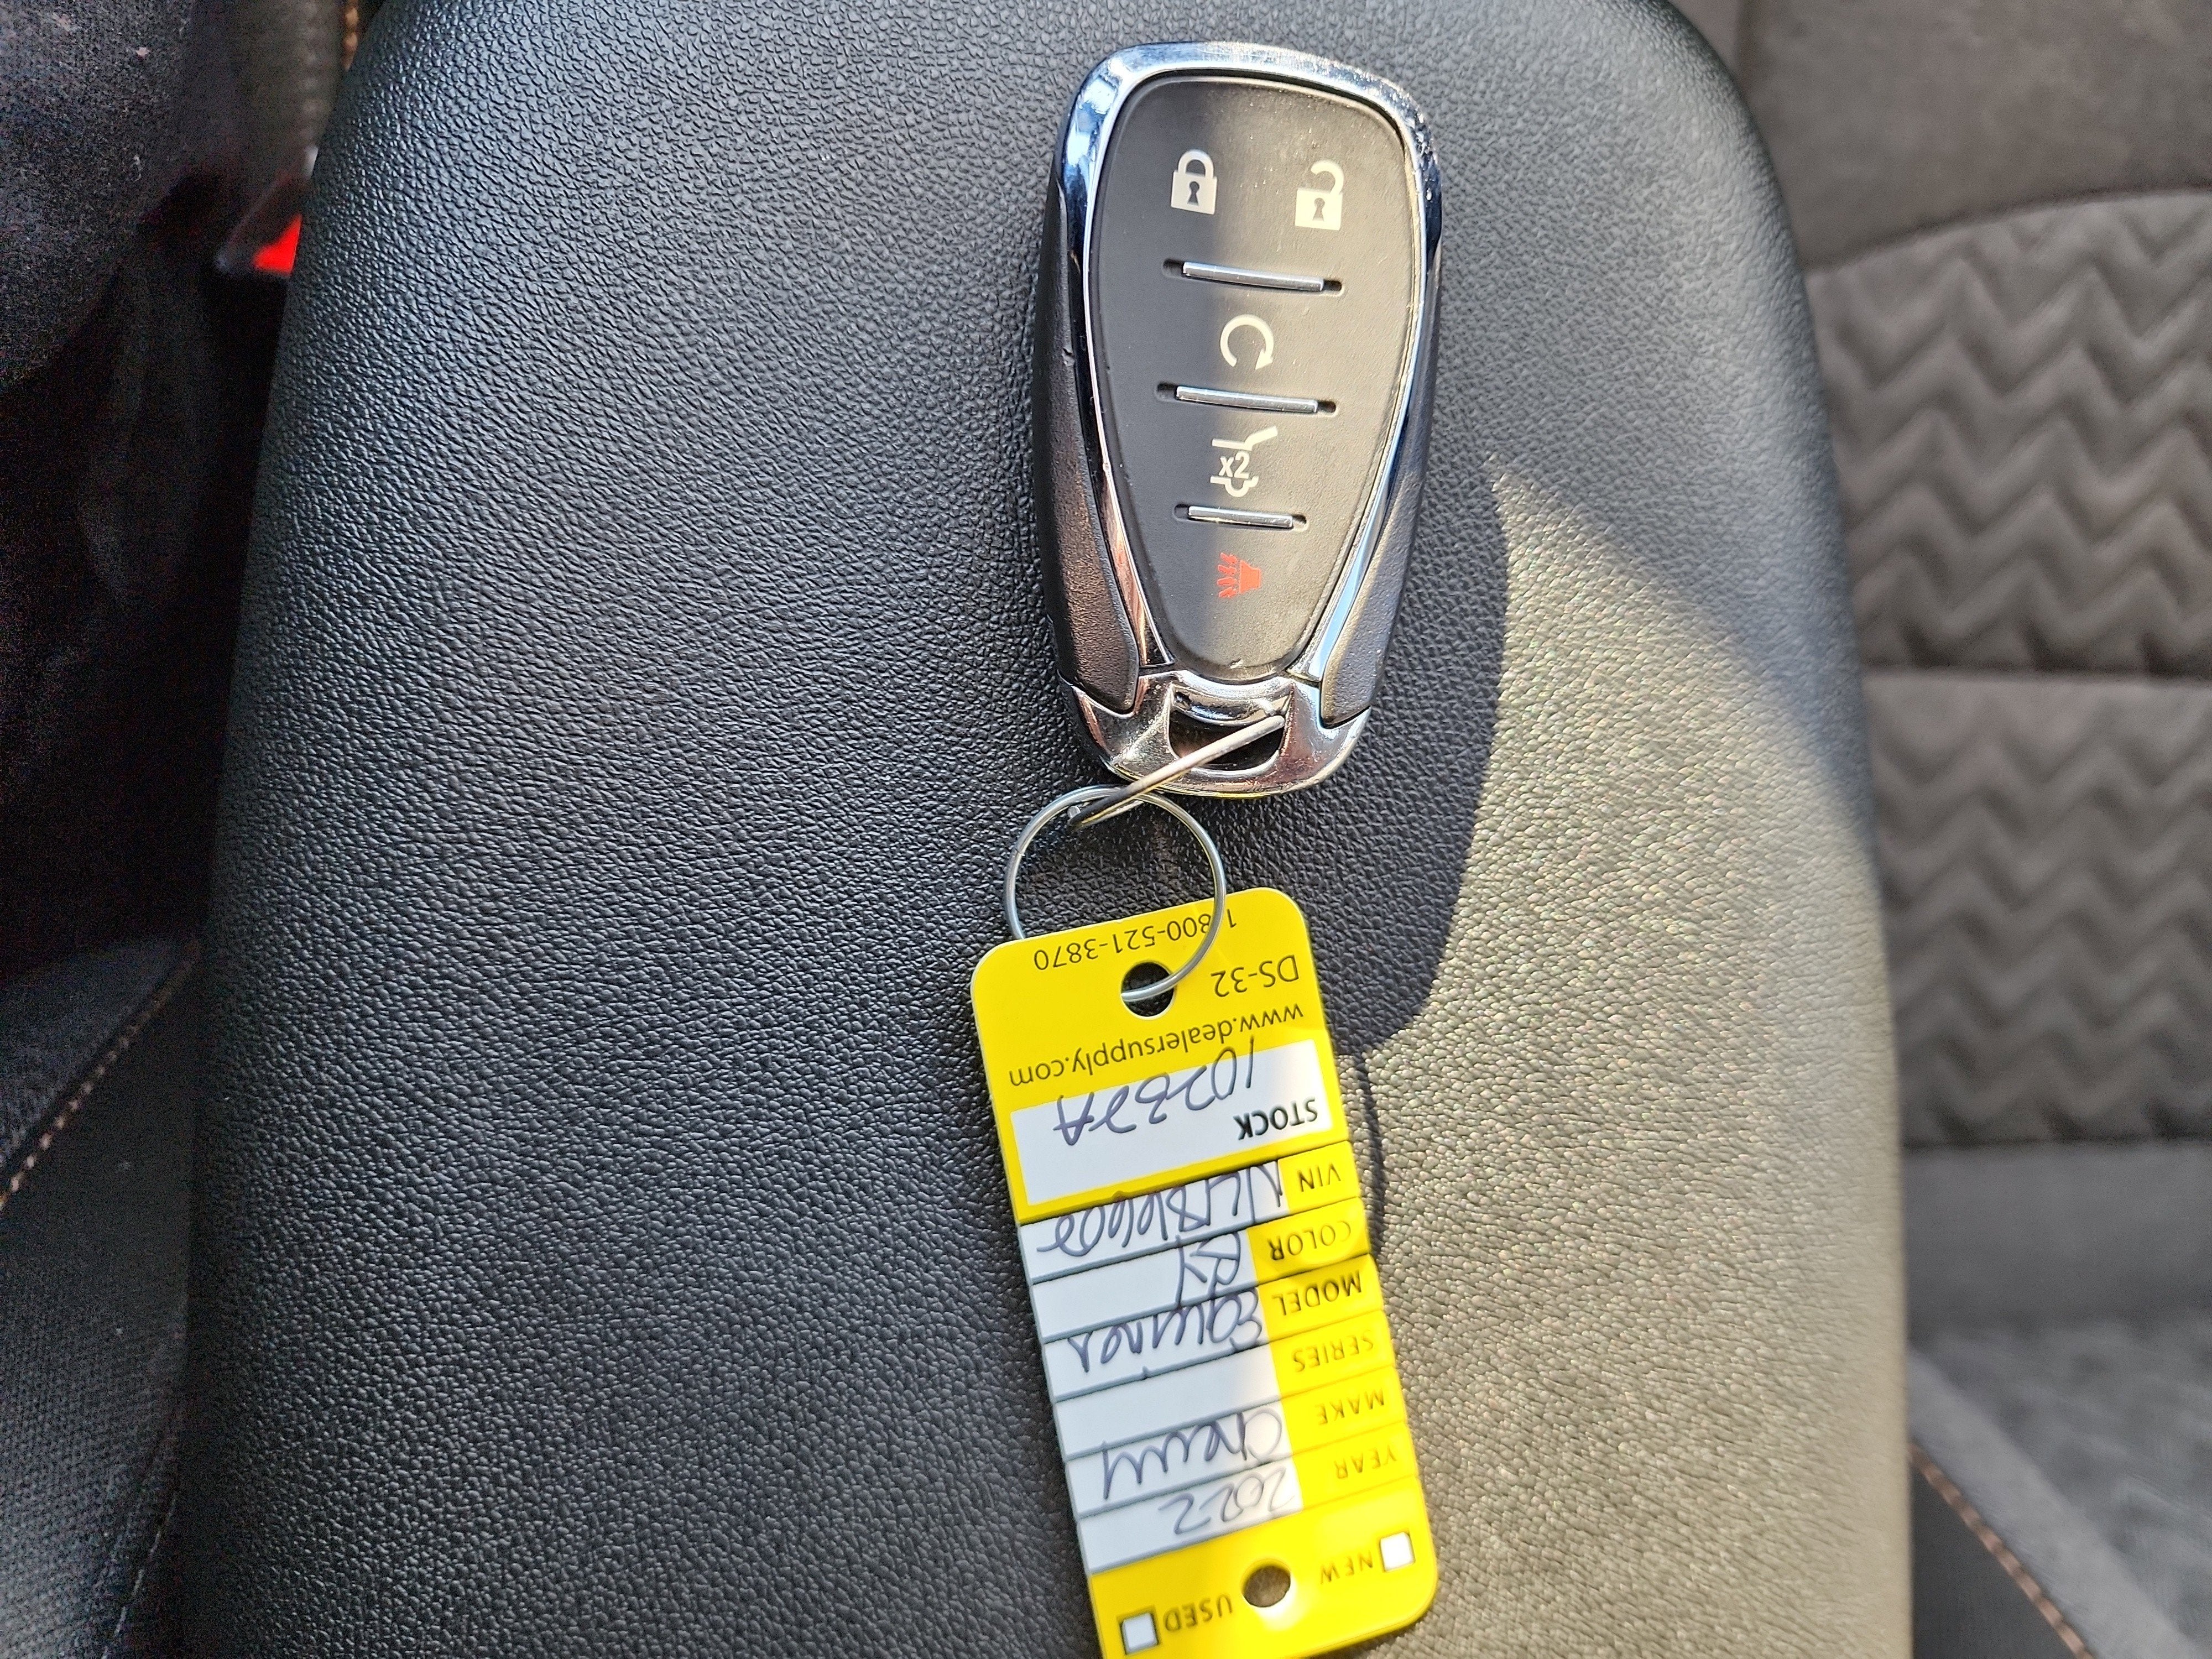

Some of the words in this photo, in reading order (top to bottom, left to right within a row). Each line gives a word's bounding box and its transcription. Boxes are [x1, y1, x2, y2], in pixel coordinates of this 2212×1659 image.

[1034, 909, 1237, 971] 1800-521-3870
[1211, 954, 1298, 998] DS-32
[1008, 1003, 1303, 1086] www.dealersupply.com
[1237, 1098, 1318, 1139] STOCK
[1298, 1167, 1342, 1192] VIN
[1269, 1220, 1352, 1261] COLOR
[1272, 1270, 1363, 1317] MODEL
[1292, 1329, 1374, 1371] SERIES
[1318, 1387, 1385, 1424] MAKE
[1335, 1449, 1397, 1479] YEAR
[1159, 1465, 1295, 1536] 2022
[1318, 1554, 1374, 1584] NEW
[1165, 1592, 1233, 1630] USED
